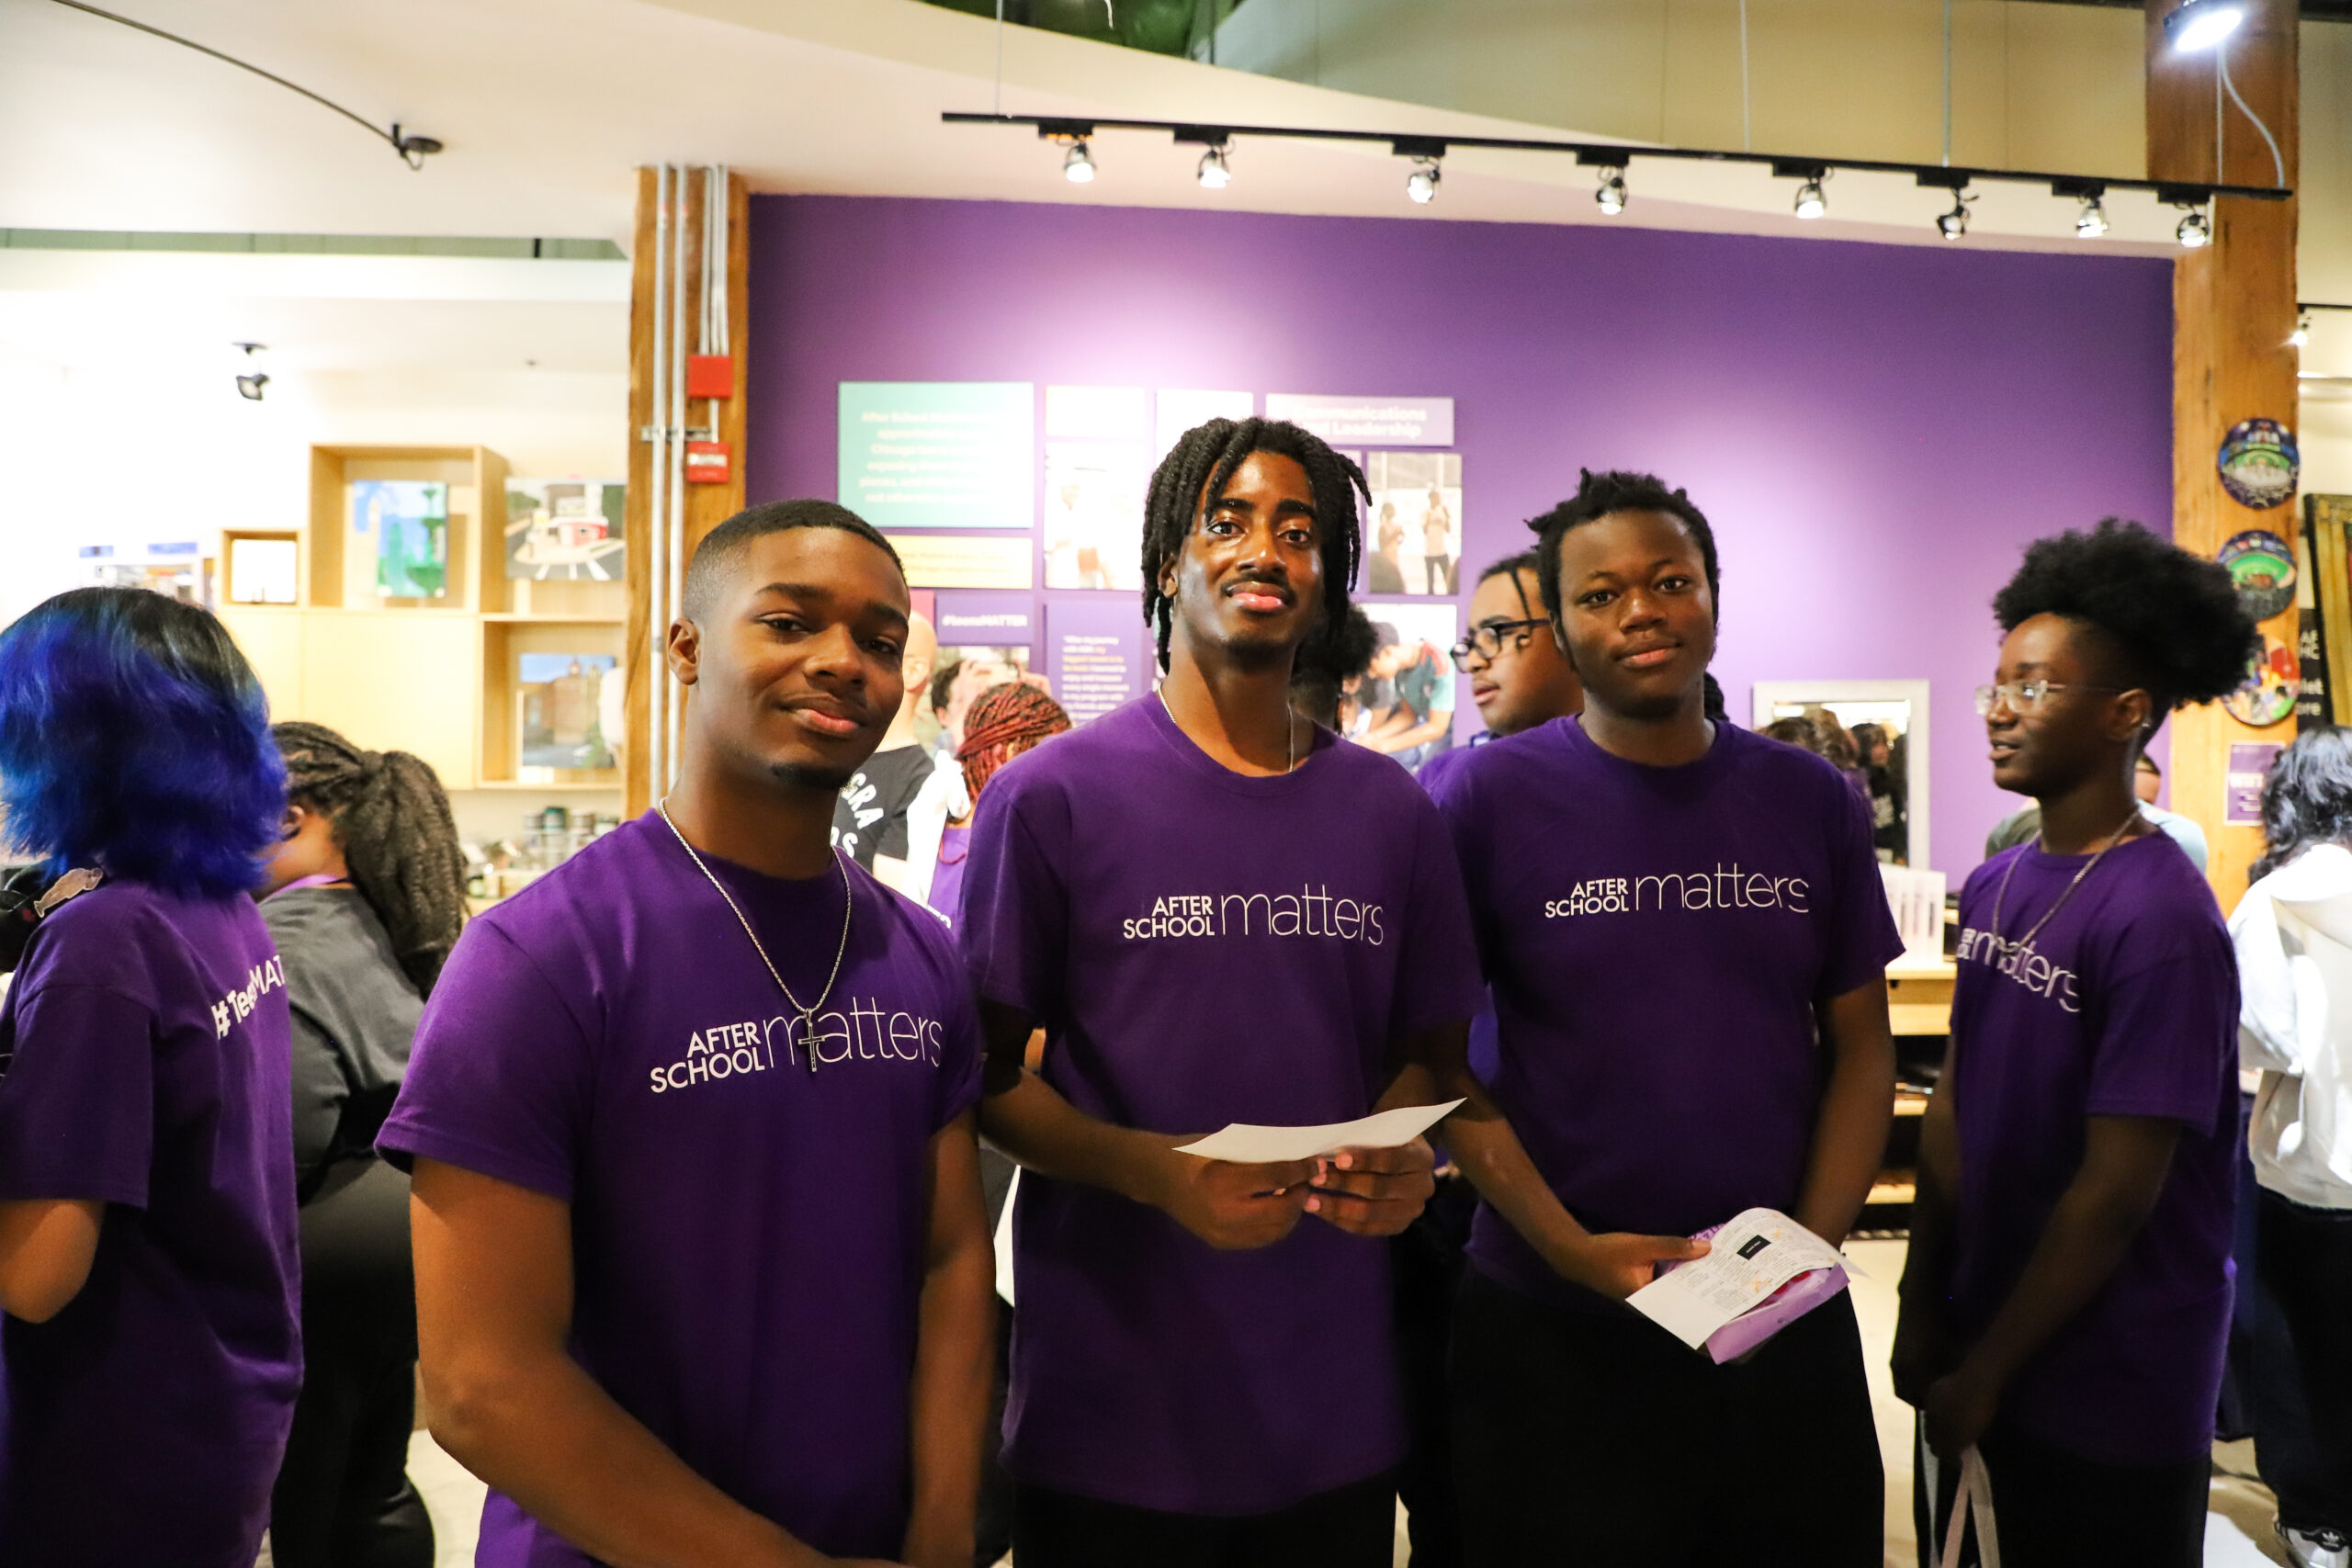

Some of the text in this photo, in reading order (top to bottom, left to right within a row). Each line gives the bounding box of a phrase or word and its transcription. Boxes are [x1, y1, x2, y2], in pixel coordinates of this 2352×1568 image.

[1151, 896, 1214, 917] AFTER
[1544, 863, 1809, 919] SCHOOL matters
[1570, 878, 1628, 899] AFTER
[1123, 883, 1384, 945] SCHOOL matters
[650, 997, 943, 1093] SCHOOL matters
[686, 1021, 762, 1058] AFTER
